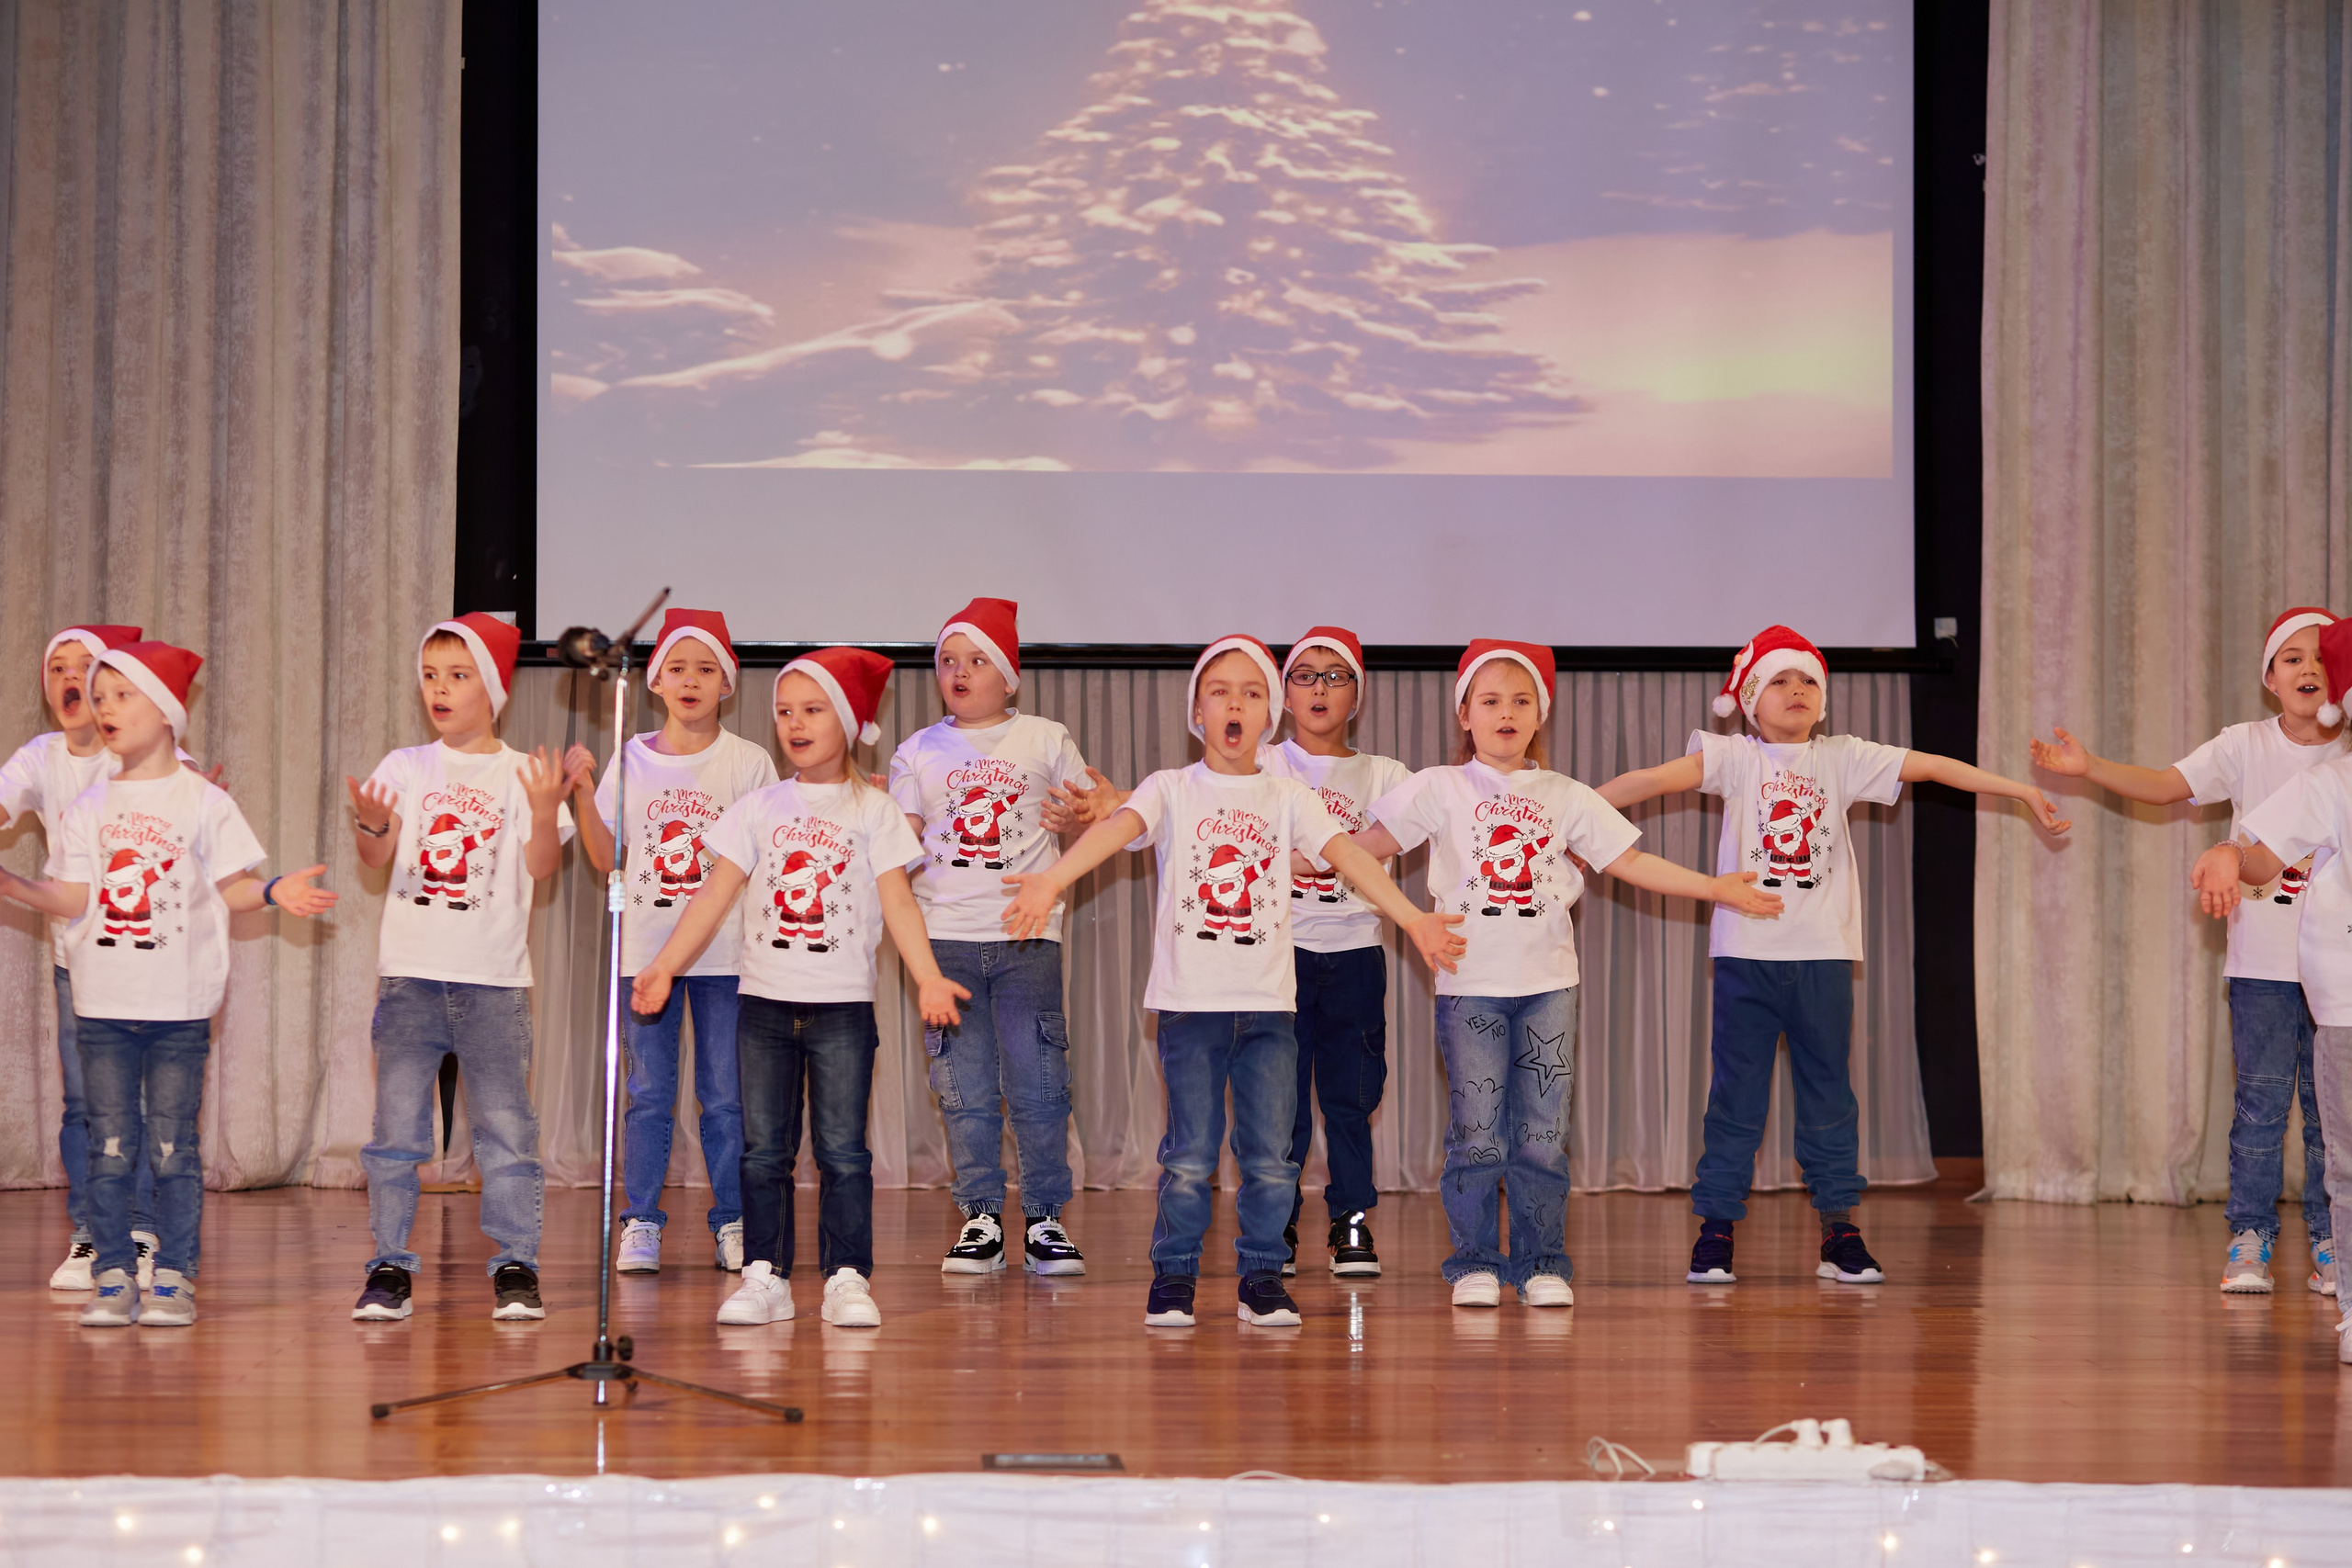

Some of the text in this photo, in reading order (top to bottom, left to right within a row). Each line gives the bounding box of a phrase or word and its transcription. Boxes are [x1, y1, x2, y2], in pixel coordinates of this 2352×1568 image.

[975, 759, 1016, 773] Merry
[946, 767, 1030, 795] Christmas
[1783, 769, 1815, 786] Merry
[452, 783, 495, 805] Merry
[673, 789, 713, 805] Merry
[1317, 786, 1354, 807] Merry
[1504, 794, 1544, 812] Merry
[1761, 780, 1828, 810] Christmas
[647, 799, 719, 821] Christma
[1227, 808, 1269, 832] Merry
[127, 812, 173, 832] Merry
[803, 817, 842, 836] Merry
[99, 824, 186, 861] Christmas
[773, 825, 855, 863] Christmas
[1196, 818, 1281, 860] Christmas
[1465, 1014, 1506, 1041] YES NO
